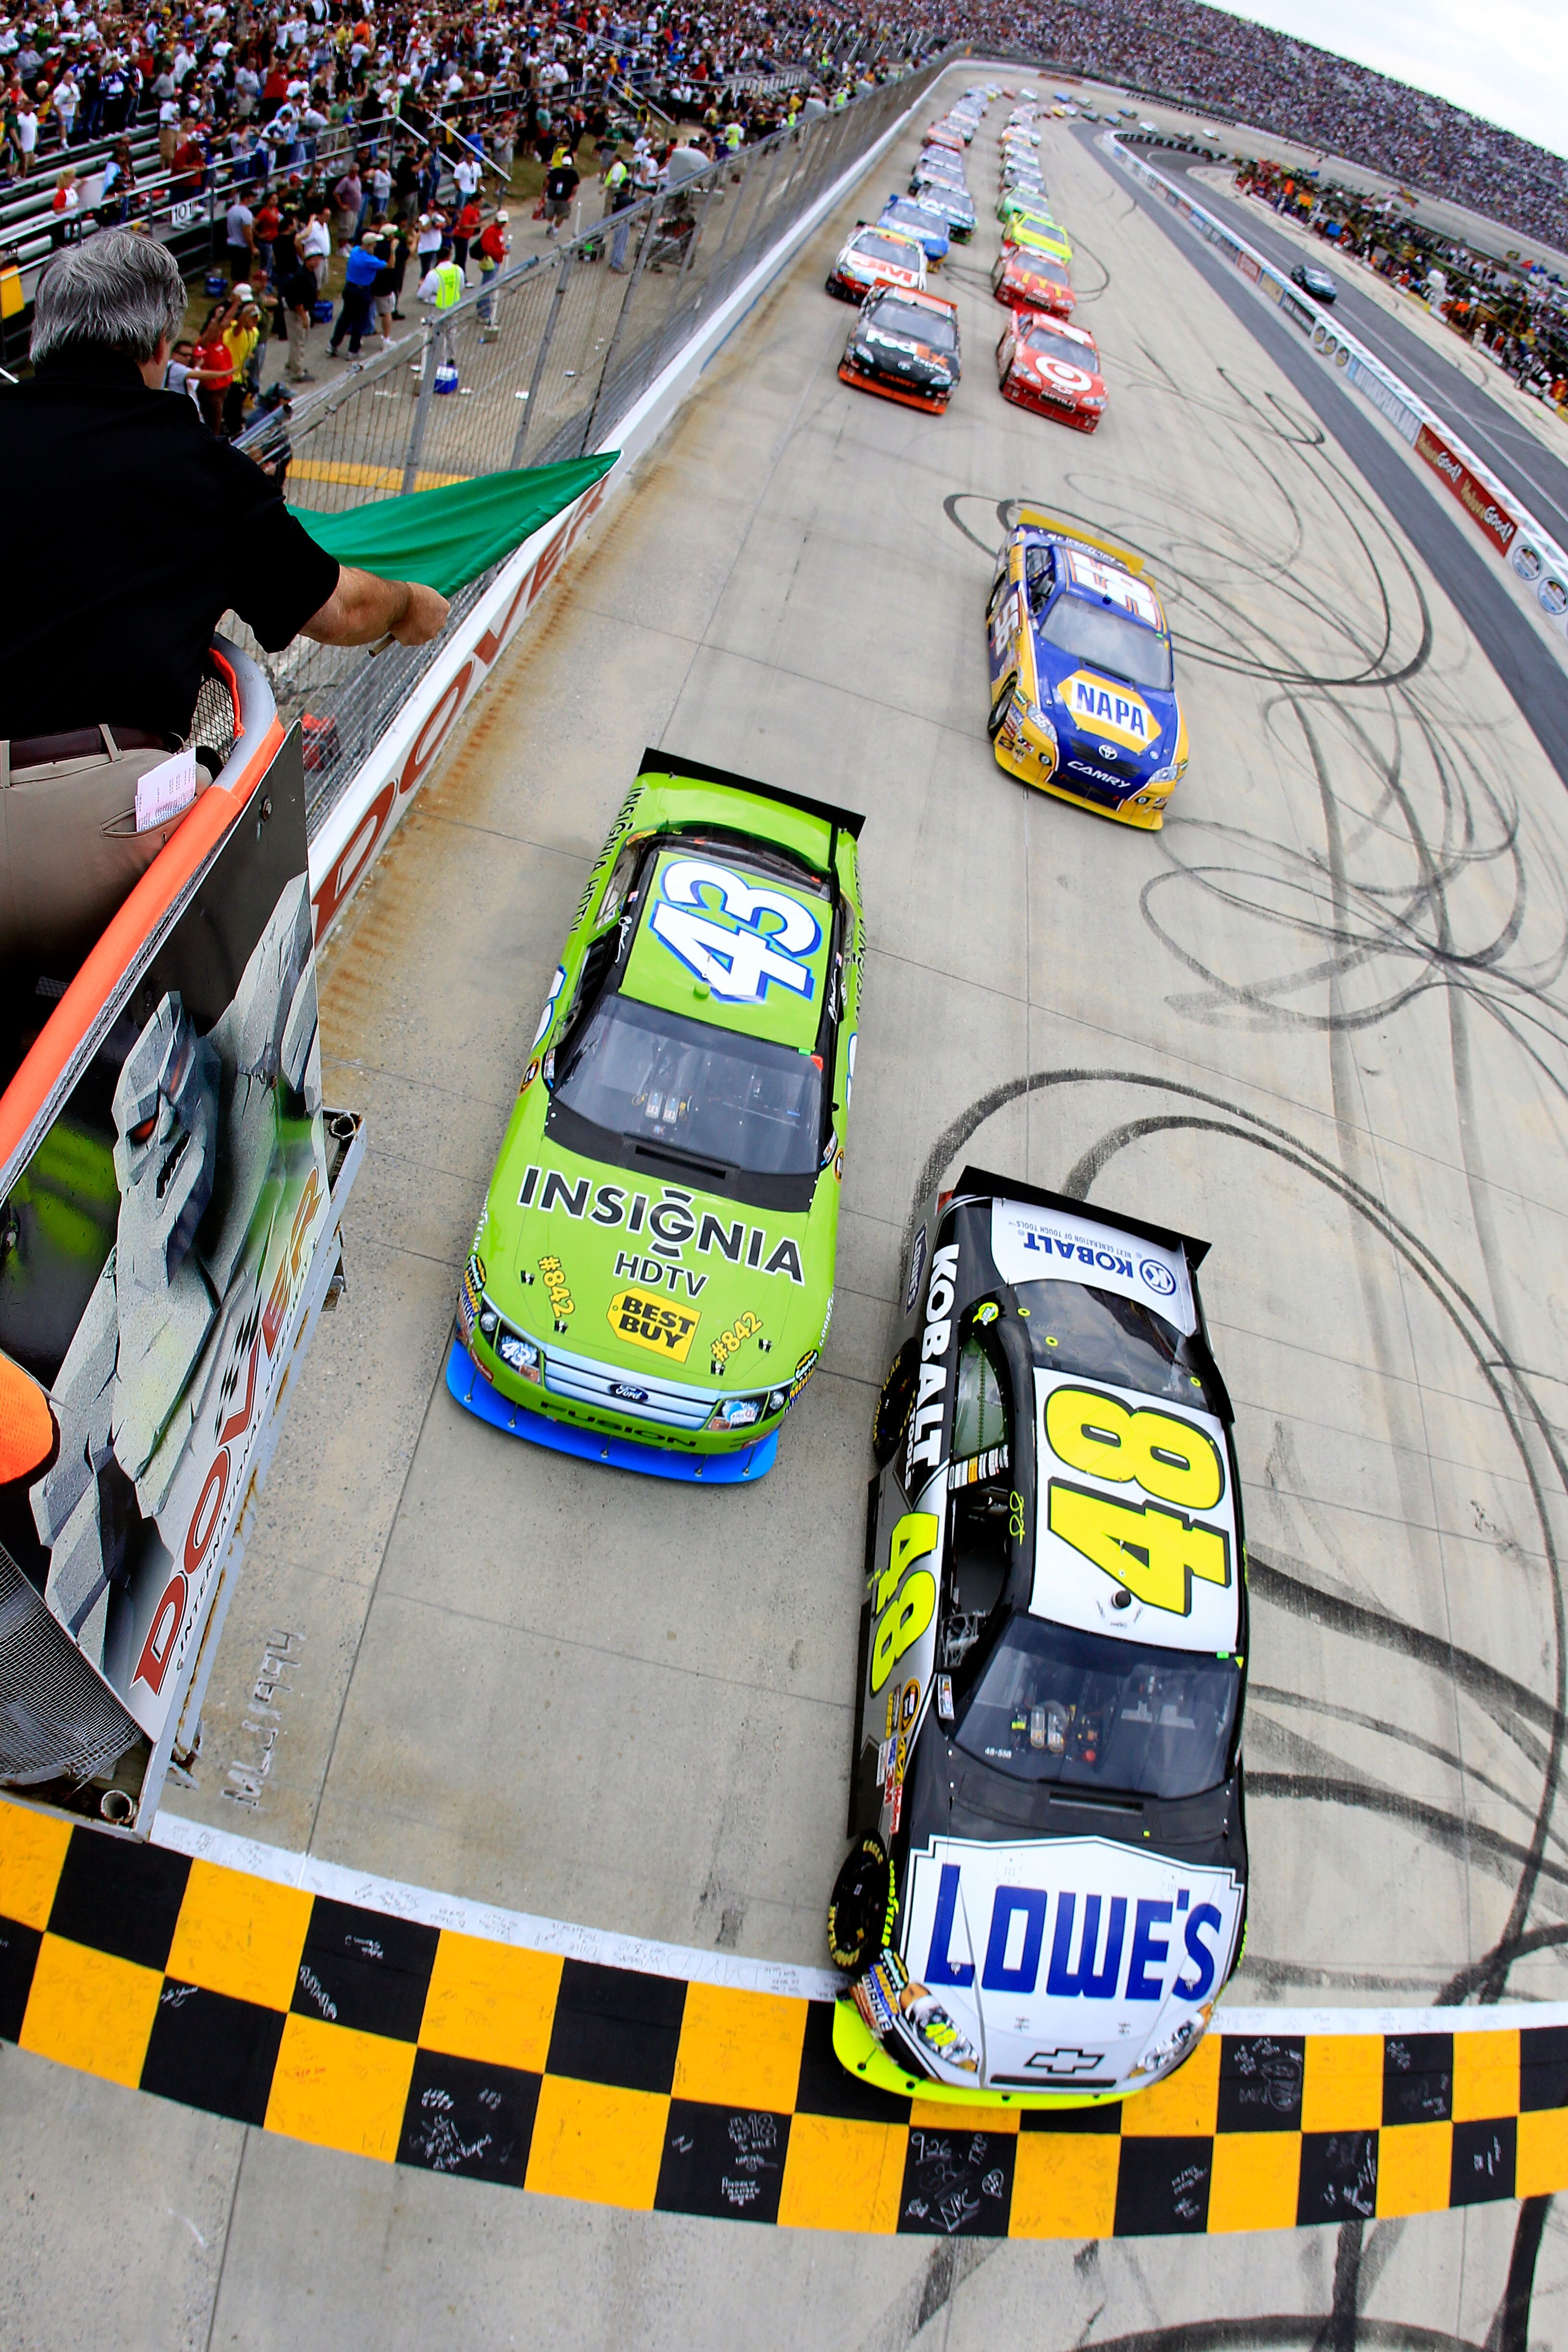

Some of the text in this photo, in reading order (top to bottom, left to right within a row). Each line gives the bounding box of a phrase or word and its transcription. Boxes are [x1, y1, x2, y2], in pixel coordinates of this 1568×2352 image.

[866, 329, 949, 370] FedEx
[311, 471, 611, 945] DOVER
[1077, 683, 1145, 737] NAPA
[1067, 760, 1131, 788] CAMRY
[591, 785, 647, 874] INSIGNIA
[649, 859, 823, 1005] 43
[516, 1164, 806, 1286] INSIGNIA
[1039, 1226, 1062, 1238] TOUGH
[1063, 1232, 1073, 1241] OF
[1074, 1235, 1114, 1253] GENERATION
[612, 1250, 709, 1299] HDTV
[1023, 1232, 1134, 1279] KOBALT
[1116, 1248, 1132, 1259] NEXT
[538, 1255, 576, 1318] #842
[618, 1313, 689, 1349] BUY
[622, 1295, 696, 1332] BEST
[710, 1311, 764, 1363] #842
[501, 1342, 531, 1367] 43
[912, 1244, 960, 1467] KOBALT
[614, 1383, 643, 1400] Ford
[130, 1166, 325, 1698] DOVER
[539, 1400, 697, 1448] FUSION
[904, 1407, 916, 1490] TOOLS
[179, 1248, 310, 1653] INTERNATIONAL SPEEDWAY
[1043, 1384, 1230, 1617] 48
[870, 1512, 940, 1698] 48
[924, 1863, 1222, 2002] LOWE'S
[861, 1973, 893, 2033] MAHLE
[925, 2022, 957, 2047] 48
